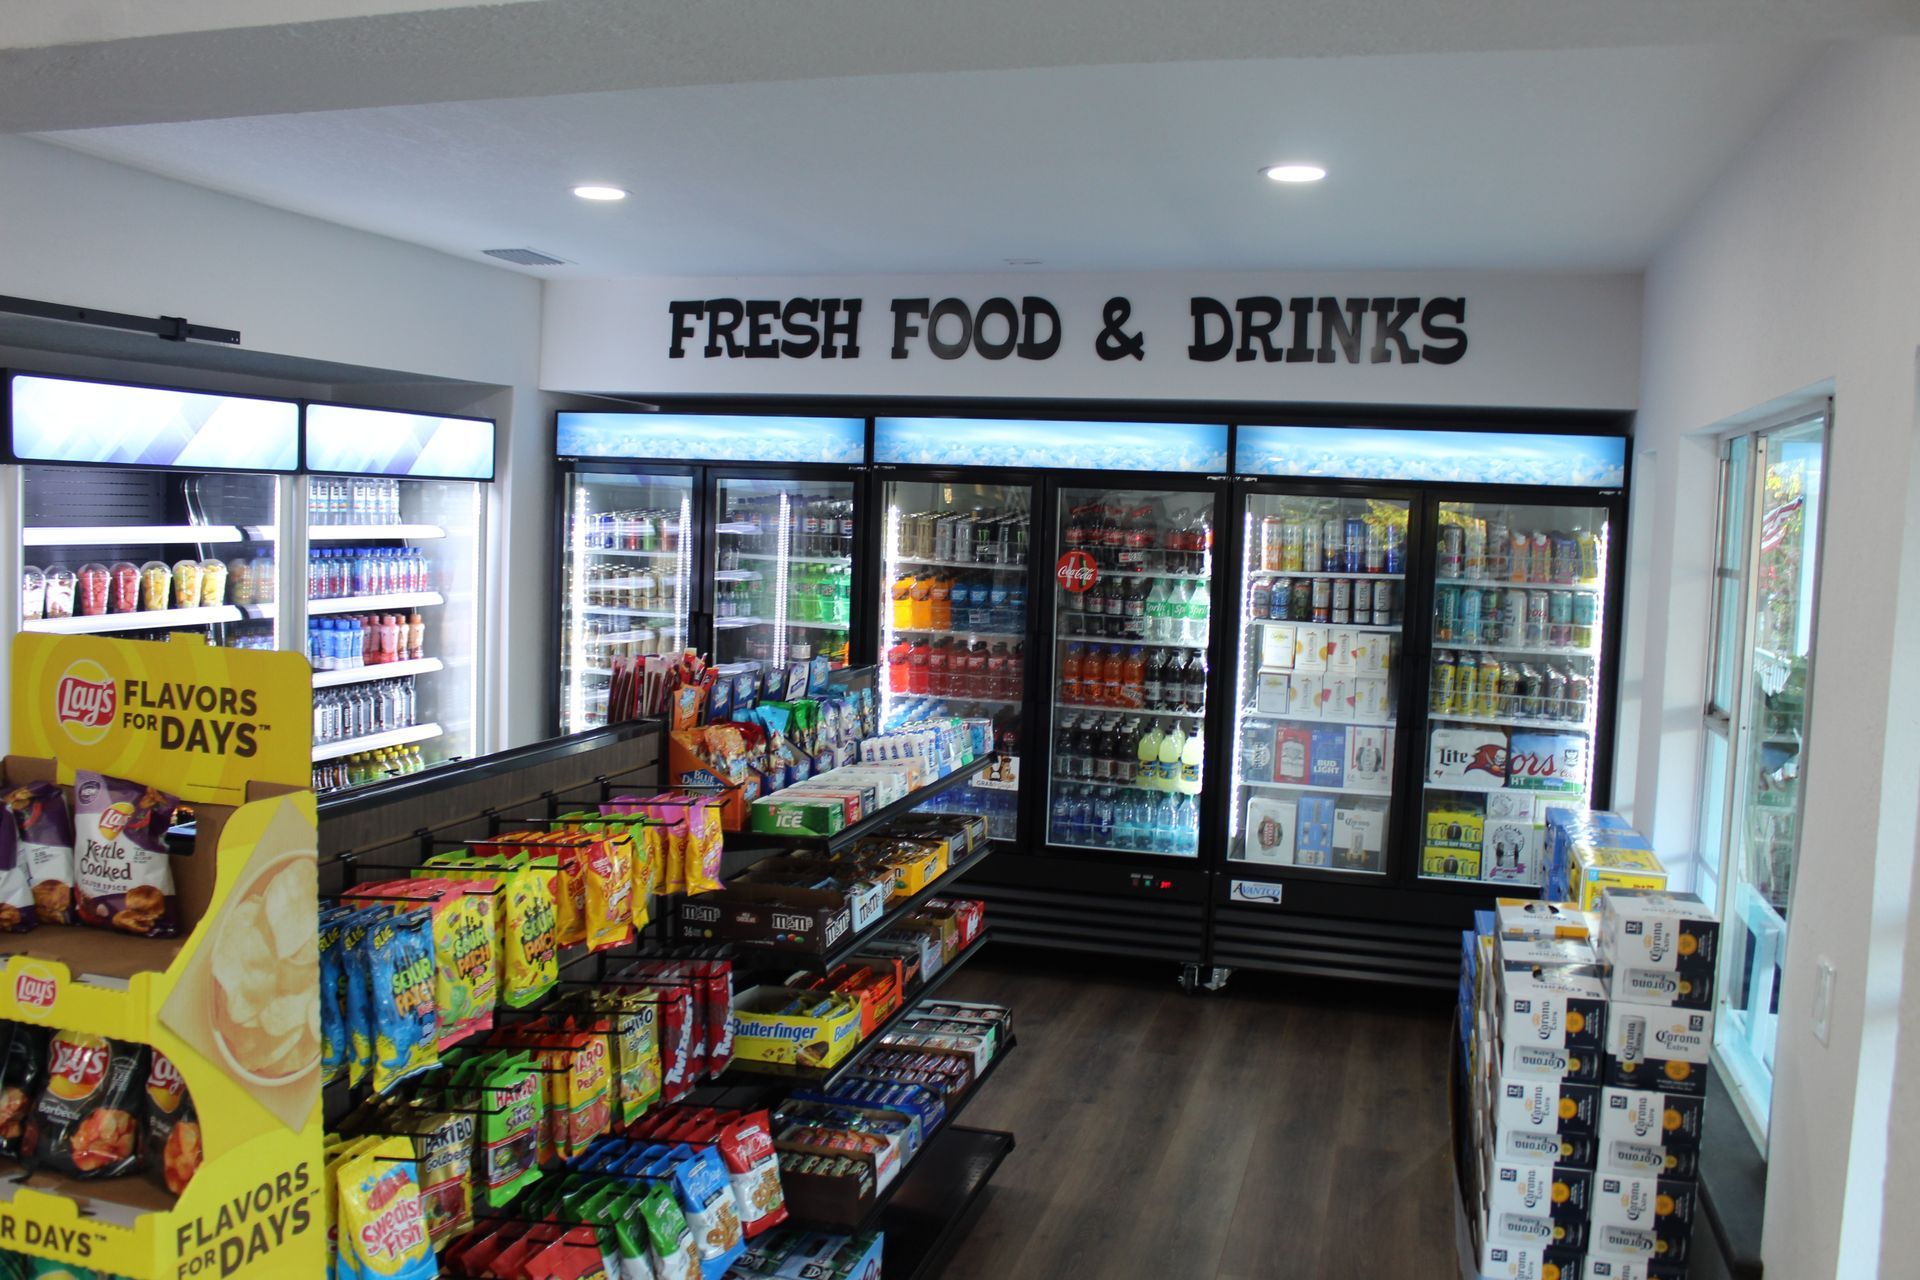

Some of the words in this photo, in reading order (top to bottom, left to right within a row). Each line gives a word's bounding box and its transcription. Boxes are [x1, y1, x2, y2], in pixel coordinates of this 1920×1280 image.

[669, 298, 862, 361] FRESH
[890, 296, 1061, 361] FOOD
[1095, 297, 1145, 362] &
[1188, 296, 1468, 365] DRINKS
[58, 677, 117, 726] Lay's
[124, 680, 257, 716] FLAVORS
[123, 713, 158, 731] FOR
[1316, 760, 1337, 768] BUD
[1440, 747, 1469, 767] Lite
[1510, 752, 1557, 777] ors
[775, 815, 804, 828] ICE
[85, 840, 125, 862] Kettle
[80, 858, 132, 881] Cooked
[1650, 922, 1663, 962] Corona
[392, 959, 434, 994] SOUR
[1632, 979, 1677, 993] Corona
[18, 976, 57, 1005] Lay's
[734, 1017, 818, 1043] Butterfinger
[1539, 1002, 1550, 1040] Corona
[1655, 1029, 1701, 1045] Corona
[1522, 1055, 1566, 1070] Corona
[1531, 1086, 1543, 1125] Corona
[1635, 1097, 1647, 1137] Corona
[1515, 1141, 1558, 1154] Corona
[1618, 1152, 1662, 1166] Corona
[1525, 1170, 1536, 1208] Corona
[1628, 1182, 1640, 1221] Corona
[177, 1163, 309, 1257] FLAVORS
[383, 1222, 422, 1259] Fish
[1507, 1224, 1551, 1238] Corona
[1609, 1235, 1653, 1250] Corona
[1515, 1251, 1527, 1280] orona
